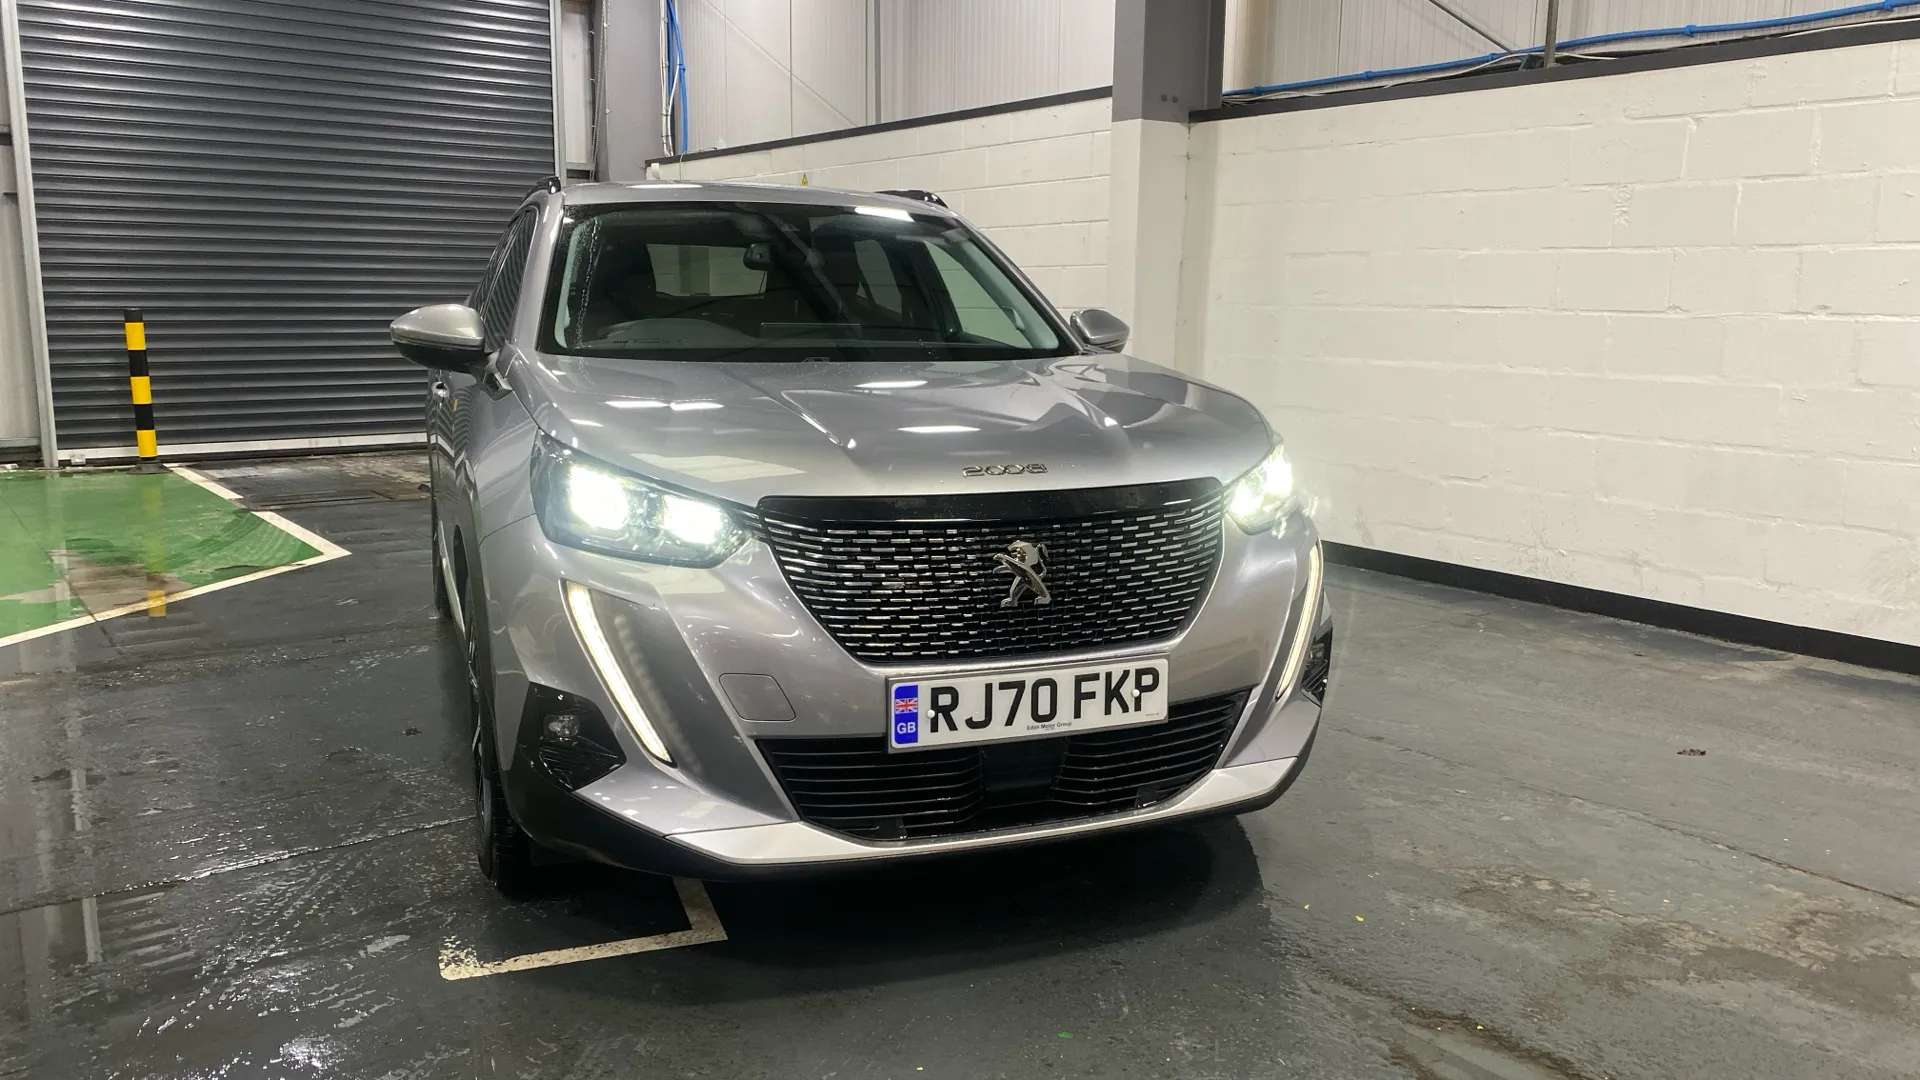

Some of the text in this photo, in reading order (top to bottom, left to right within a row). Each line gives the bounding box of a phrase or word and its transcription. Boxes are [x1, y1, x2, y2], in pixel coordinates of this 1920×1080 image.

[963, 464, 1048, 476] 2008
[929, 666, 1160, 733] RJ70 FKP
[897, 722, 916, 734] GB
